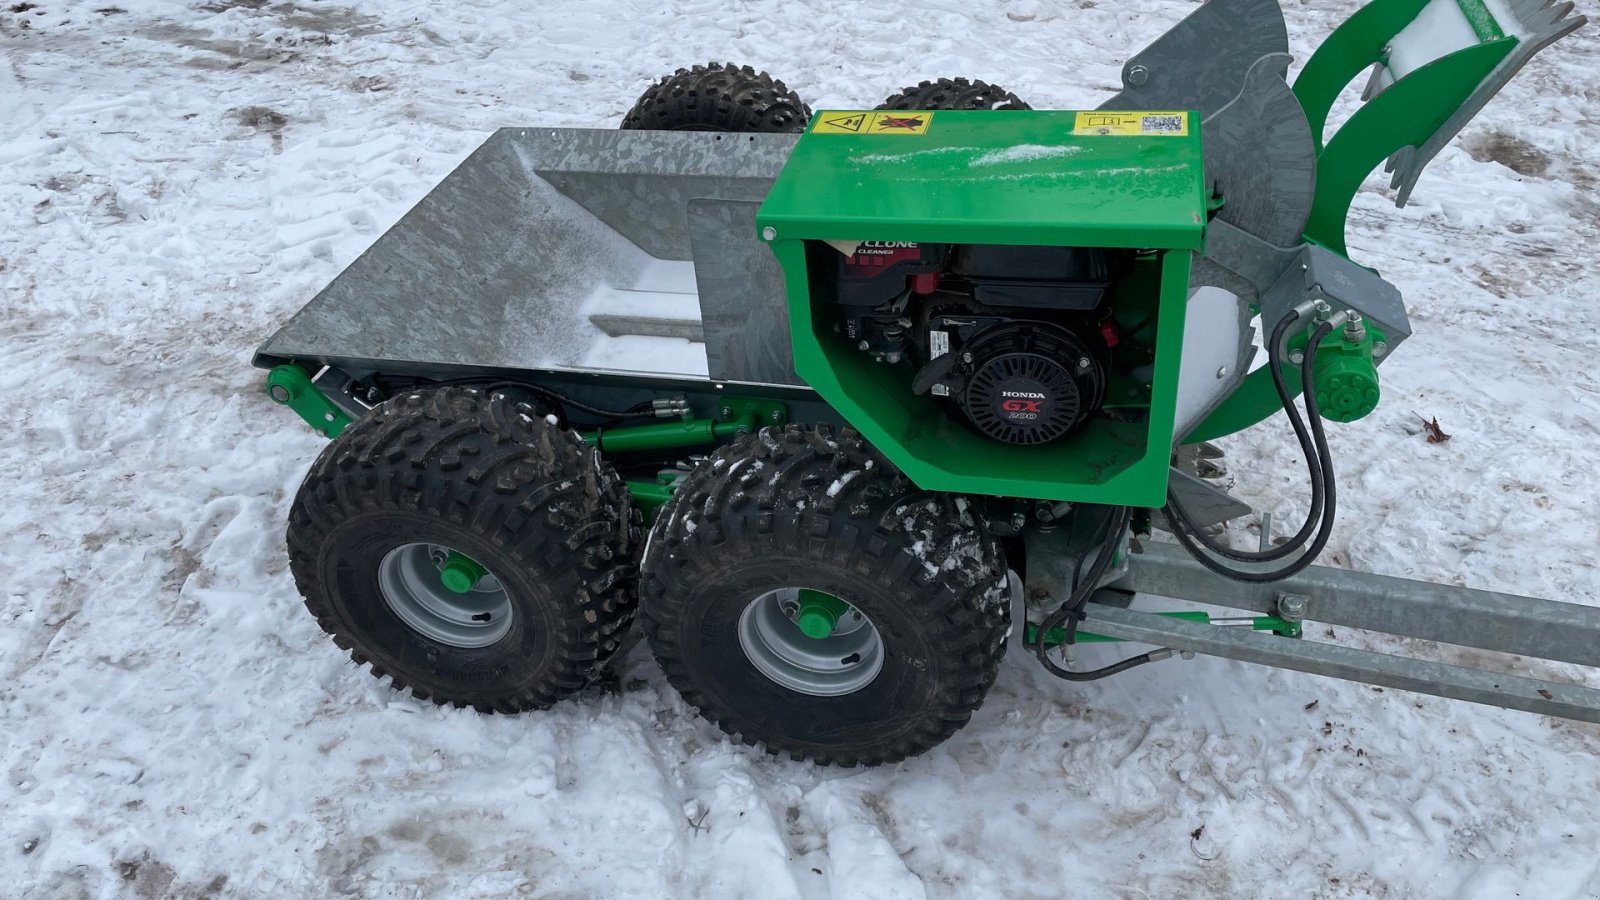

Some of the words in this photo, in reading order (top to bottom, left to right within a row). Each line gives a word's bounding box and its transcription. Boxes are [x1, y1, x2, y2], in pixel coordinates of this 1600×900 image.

[1002, 391, 1046, 399] HONDA
[1002, 399, 1044, 412] GX
[1008, 412, 1037, 420] 200
